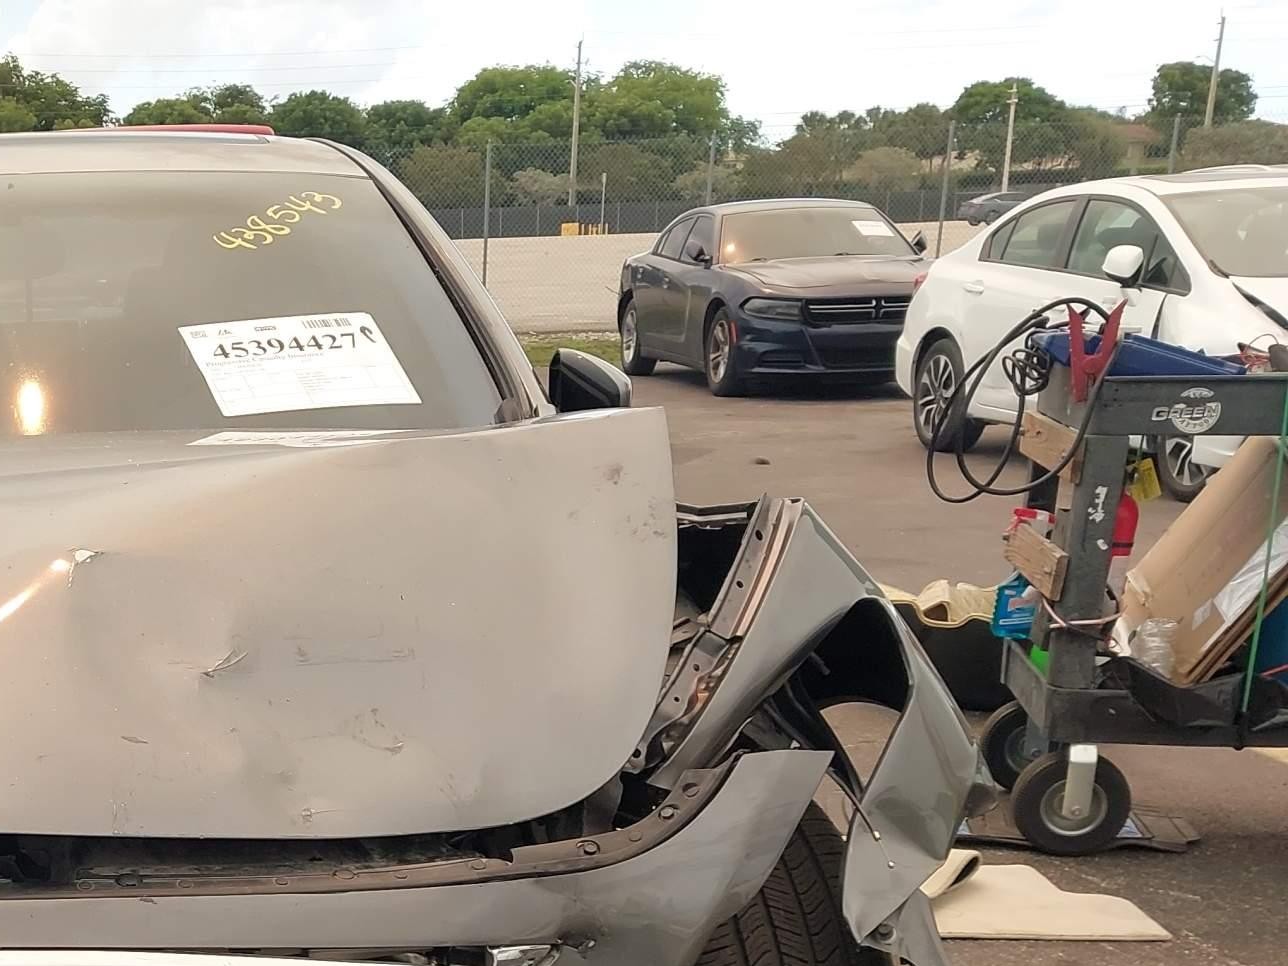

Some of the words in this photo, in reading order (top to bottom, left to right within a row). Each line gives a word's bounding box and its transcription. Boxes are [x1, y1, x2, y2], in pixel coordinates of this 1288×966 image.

[213, 191, 342, 249] 438543
[213, 332, 356, 359] 45394427
[1152, 407, 1216, 421] GREEN
